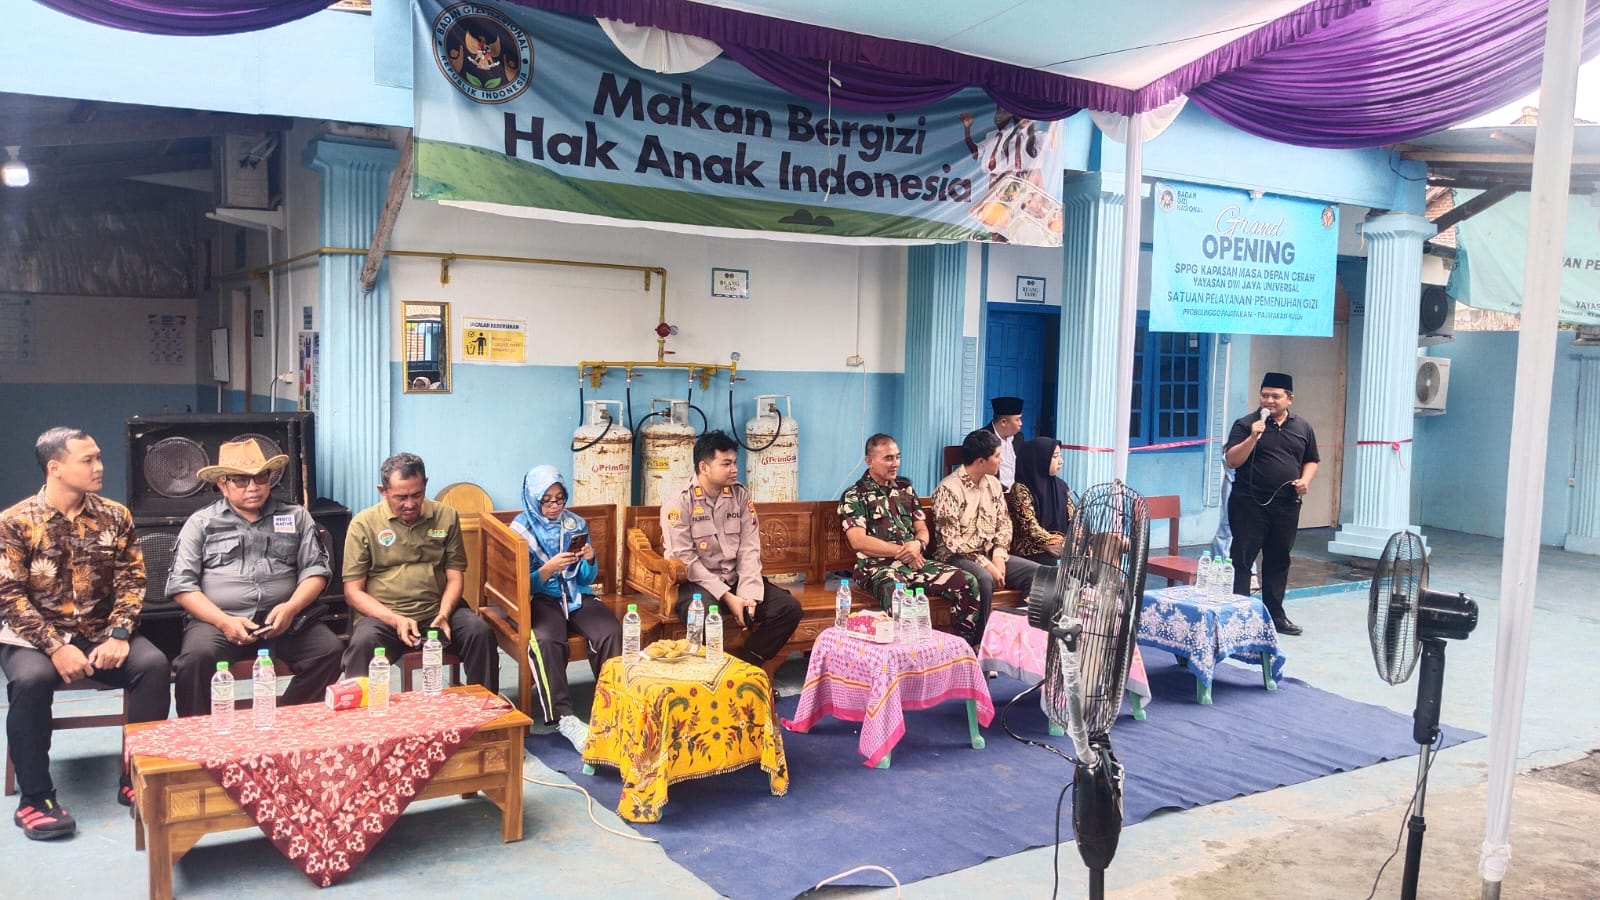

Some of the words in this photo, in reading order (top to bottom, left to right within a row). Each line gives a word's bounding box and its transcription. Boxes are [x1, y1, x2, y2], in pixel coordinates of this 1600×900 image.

[437, 8, 461, 36] BADAN
[487, 10, 529, 51] IONAL
[481, 72, 527, 99] INDONESIA
[593, 72, 772, 138] Makan
[787, 104, 926, 162] Bergizi
[504, 112, 620, 171] Hak
[635, 135, 765, 188] Anak
[779, 151, 972, 203] Indonesia
[1215, 204, 1285, 240] Grand
[1202, 234, 1296, 265] OPENING
[1561, 256, 1582, 269] AN
[1175, 263, 1198, 274] SPPG
[1201, 265, 1238, 277] KAPASAN
[1239, 267, 1262, 278] MASA
[1264, 269, 1290, 281] DEPAN
[1291, 271, 1315, 282] CERAH
[1193, 276, 1226, 288] YAYASAN
[1227, 280, 1241, 289] DWI
[1242, 281, 1261, 290] JAYA
[1263, 282, 1299, 293] UNIVERSAL
[1167, 290, 1204, 303] SATUAN
[1205, 293, 1252, 305] PELAYANAN
[1254, 295, 1302, 308] PEMENUHAN
[1303, 298, 1318, 309] GIZI
